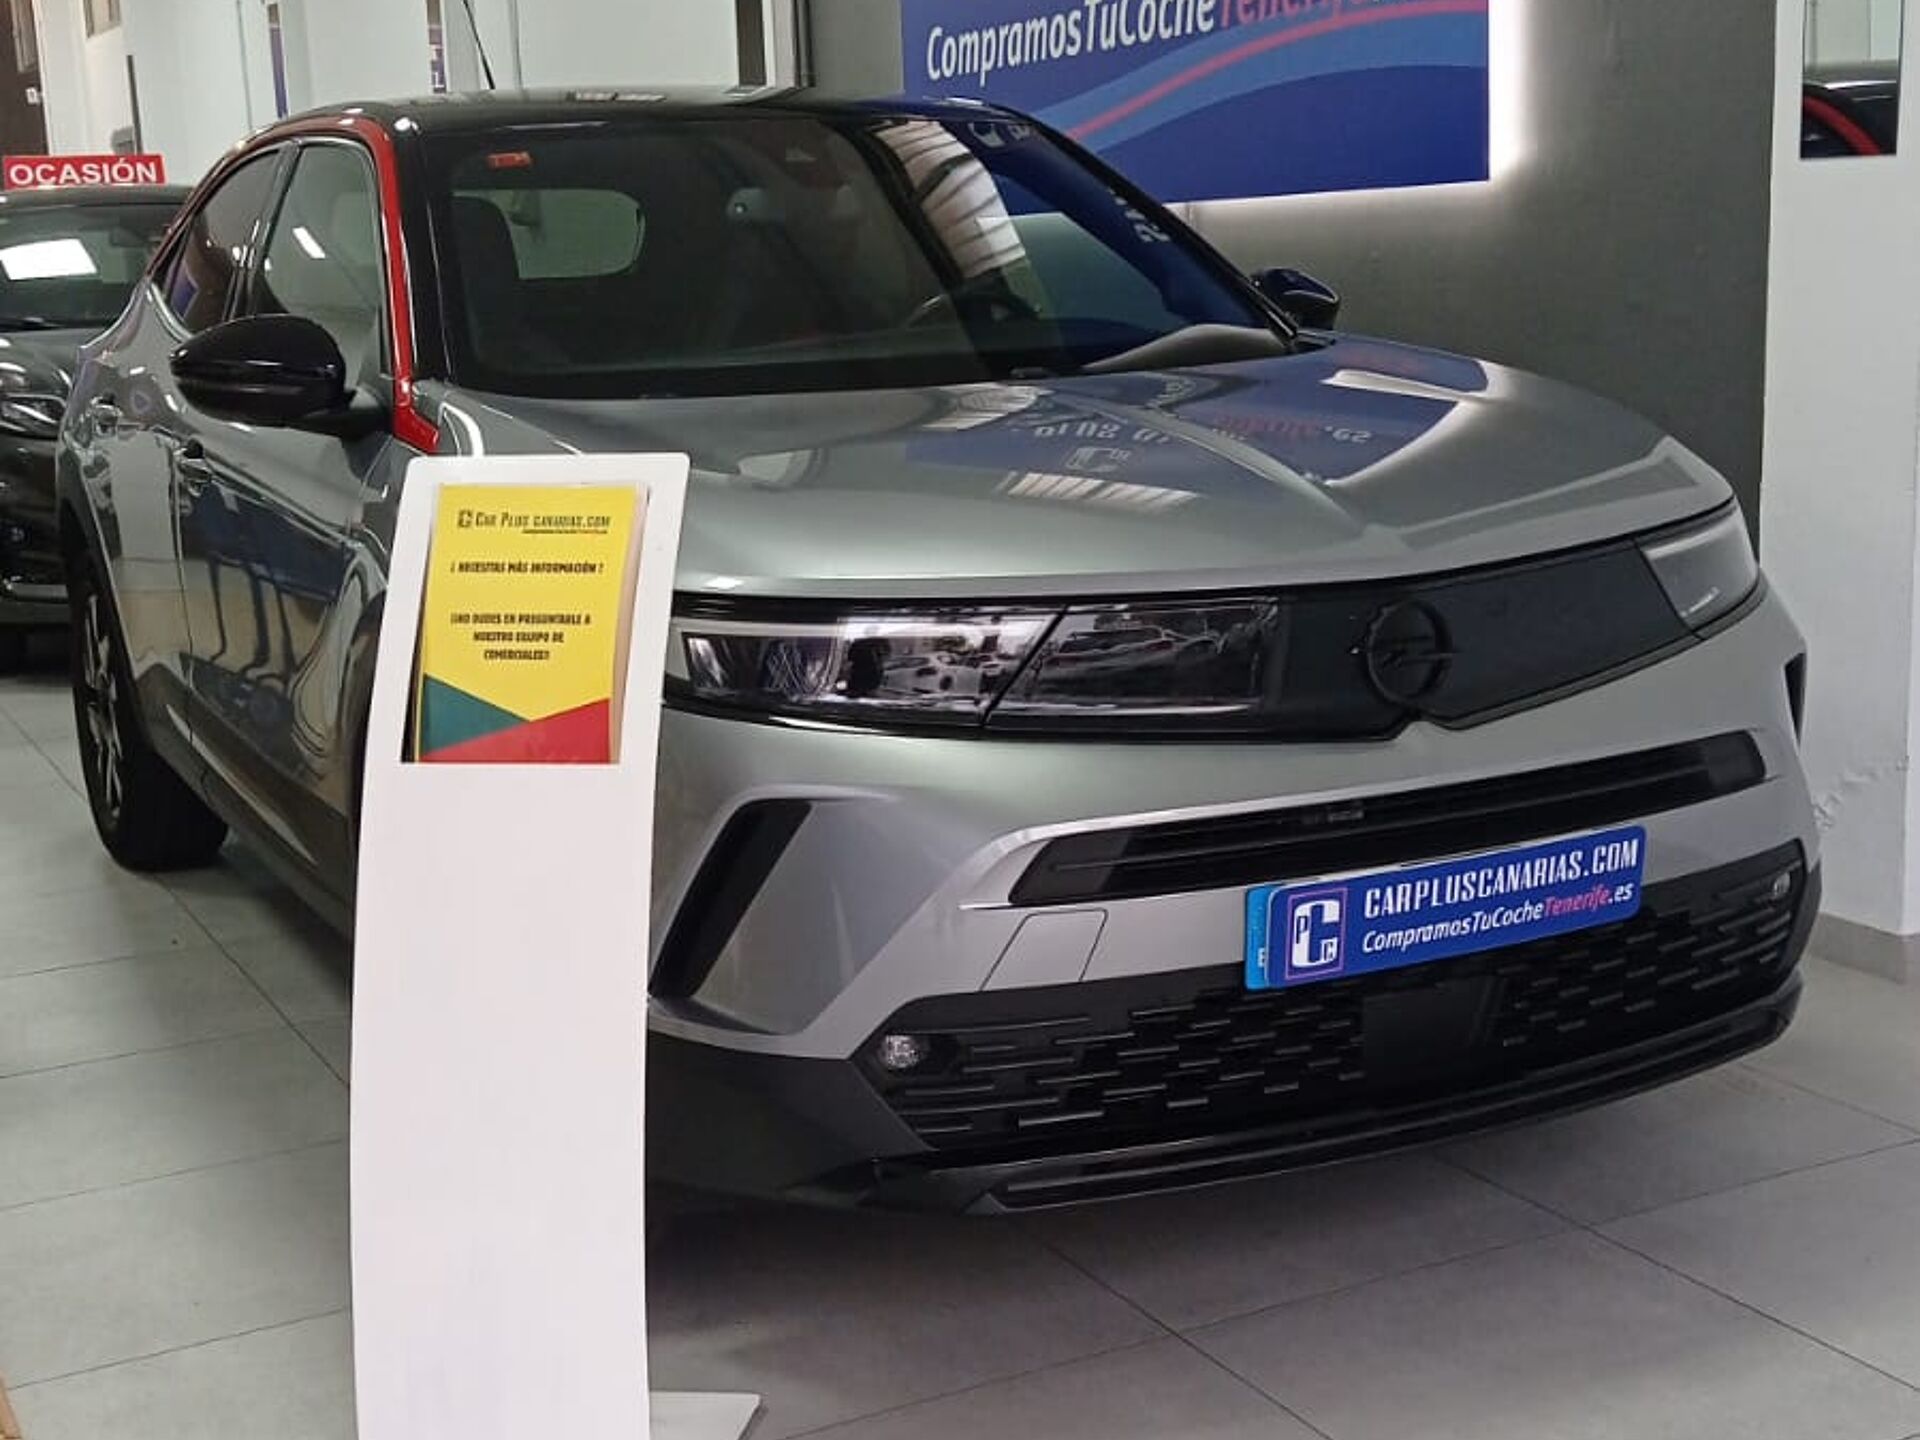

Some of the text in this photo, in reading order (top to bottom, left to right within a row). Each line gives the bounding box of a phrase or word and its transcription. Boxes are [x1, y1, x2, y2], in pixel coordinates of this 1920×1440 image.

[9, 158, 157, 185] OCASIÓN
[458, 562, 505, 573] NECESITAS
[508, 561, 528, 573] MÁS
[531, 561, 597, 573] INFORMACIÓN
[503, 613, 515, 624] EN
[518, 613, 581, 625] PREGUNTARLE
[473, 631, 564, 643] NUESTRO EQUIPO DE
[1363, 838, 1640, 920] CARPLUSCANARIAS.COM
[1361, 882, 1636, 954] CompramosTuCocheTenerife.es
